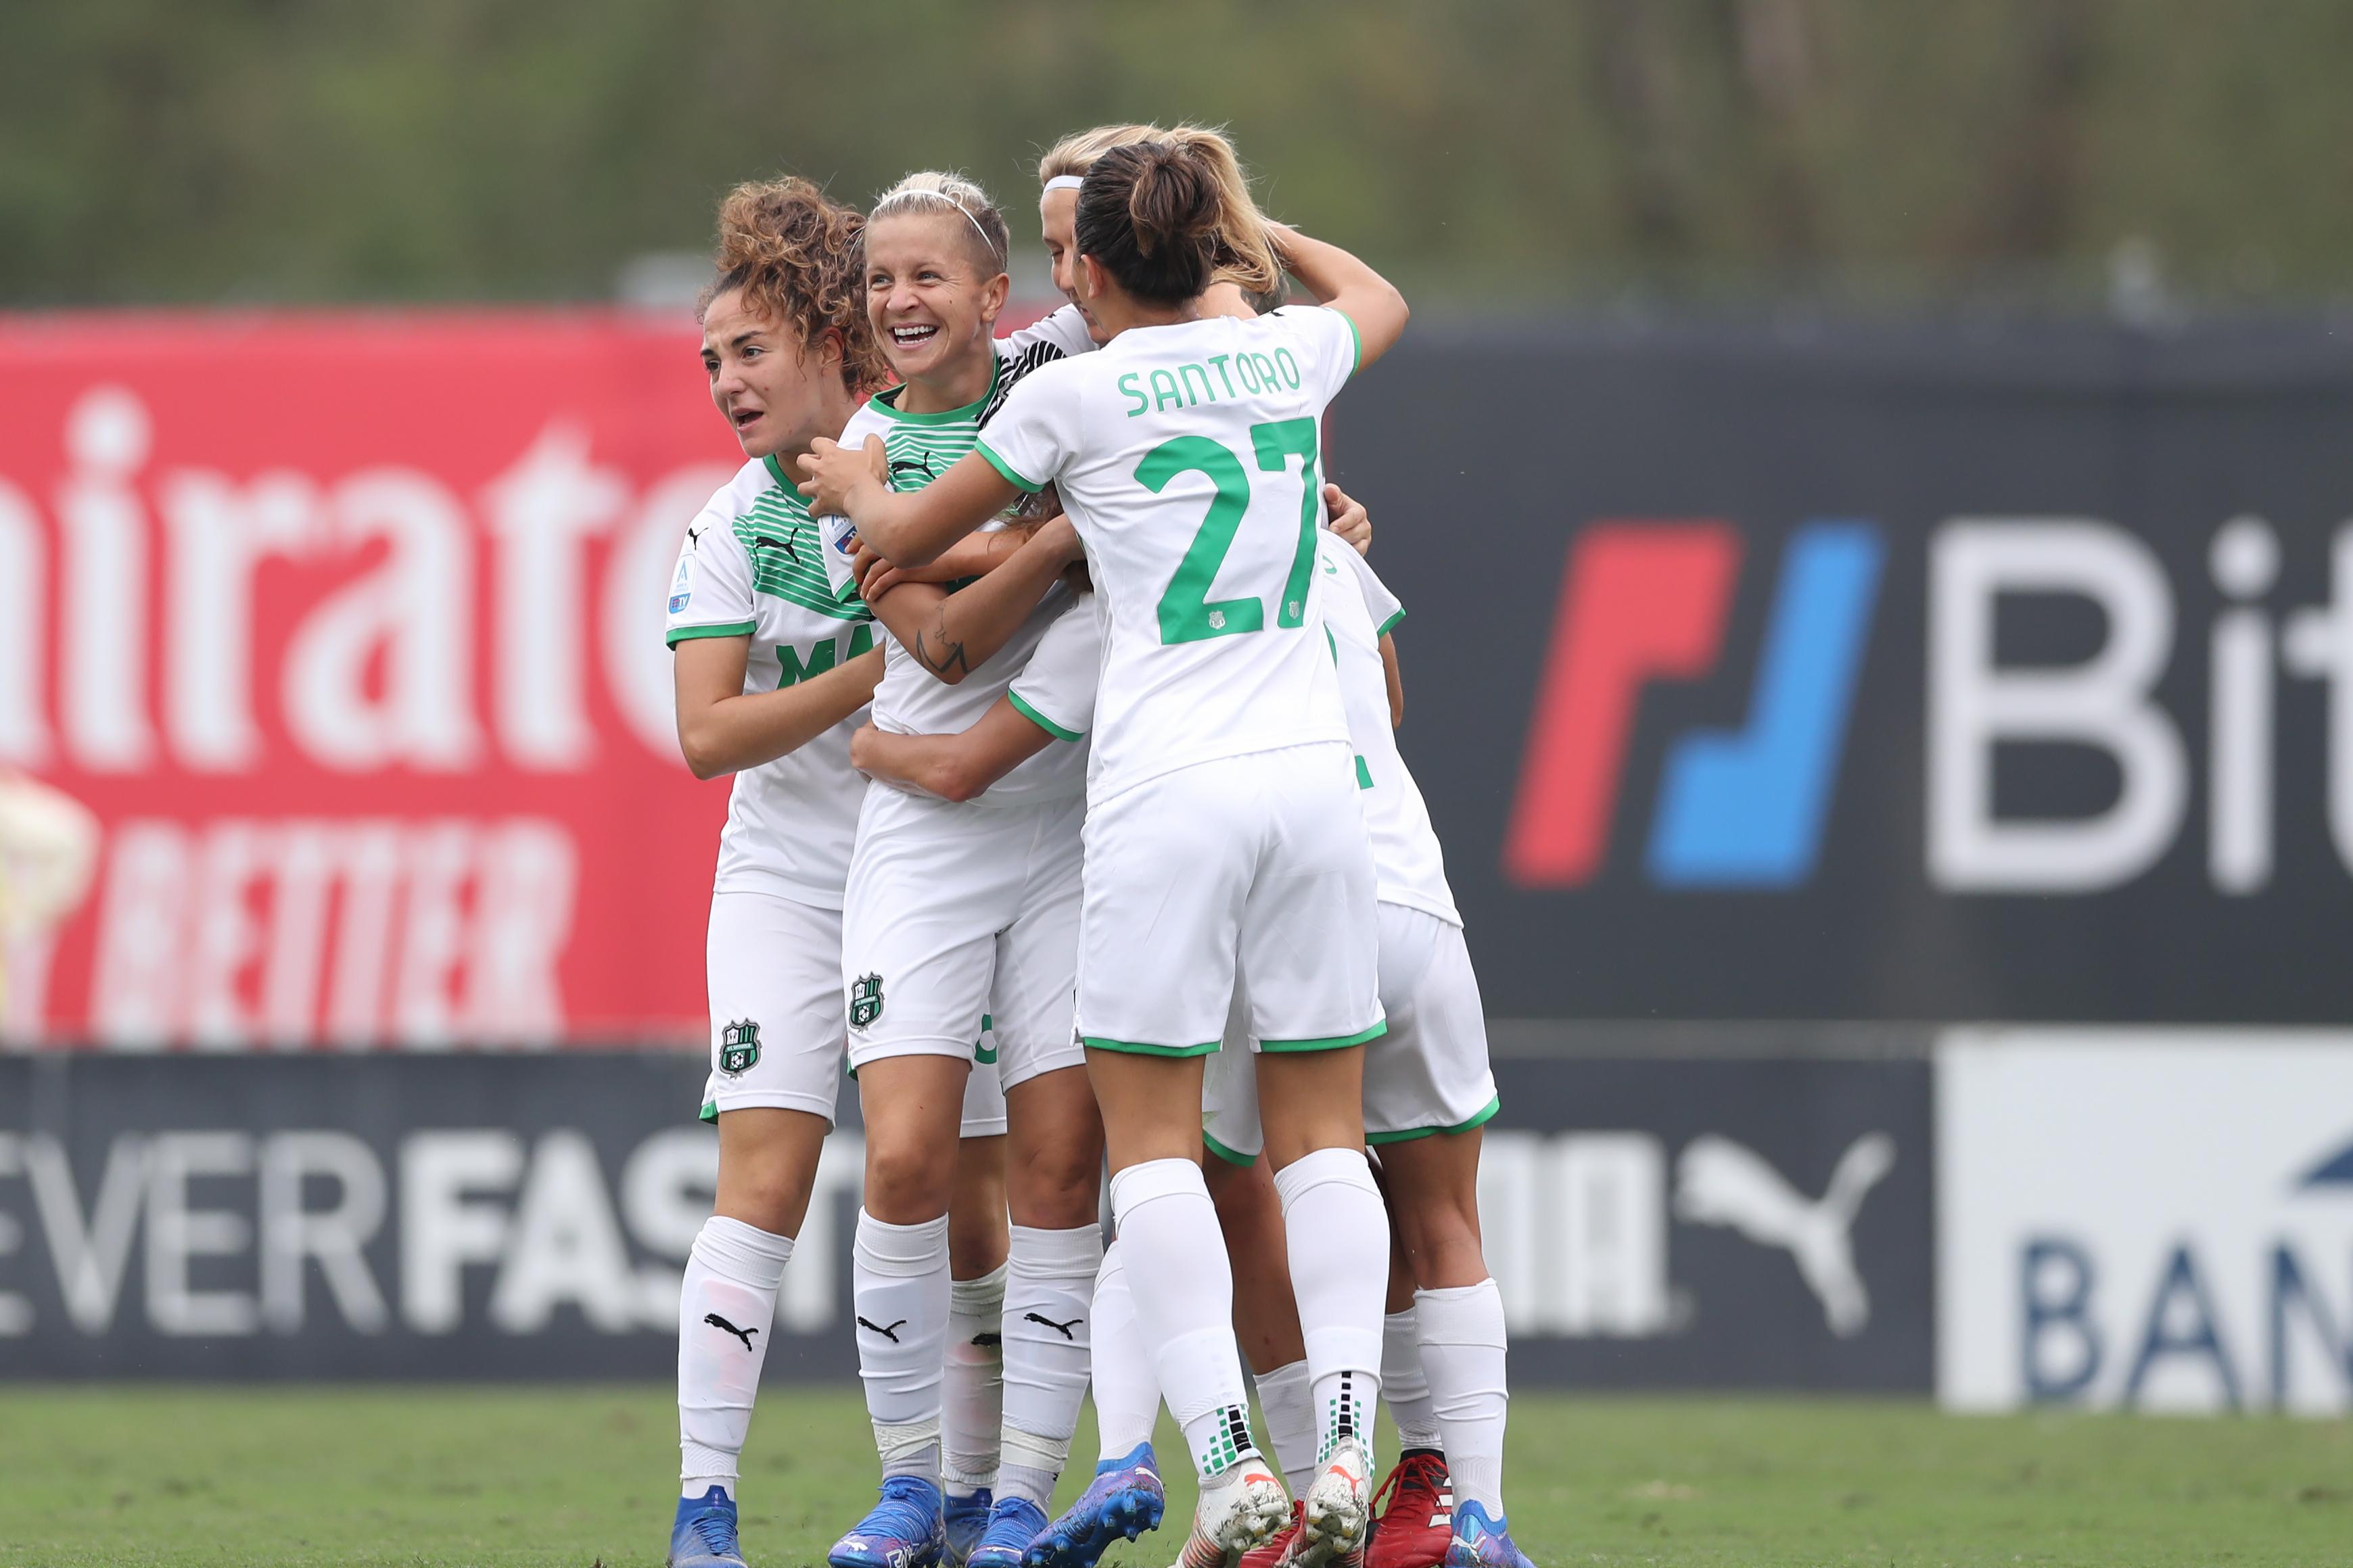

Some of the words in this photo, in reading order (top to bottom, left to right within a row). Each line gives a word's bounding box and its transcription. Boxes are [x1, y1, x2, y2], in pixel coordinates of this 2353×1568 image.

[1117, 347, 1301, 418] SANTORO
[1133, 415, 1318, 646] 27
[93, 821, 580, 1049] BETTER
[0, 1128, 392, 1336] VER
[2019, 1234, 2353, 1415] BAN
